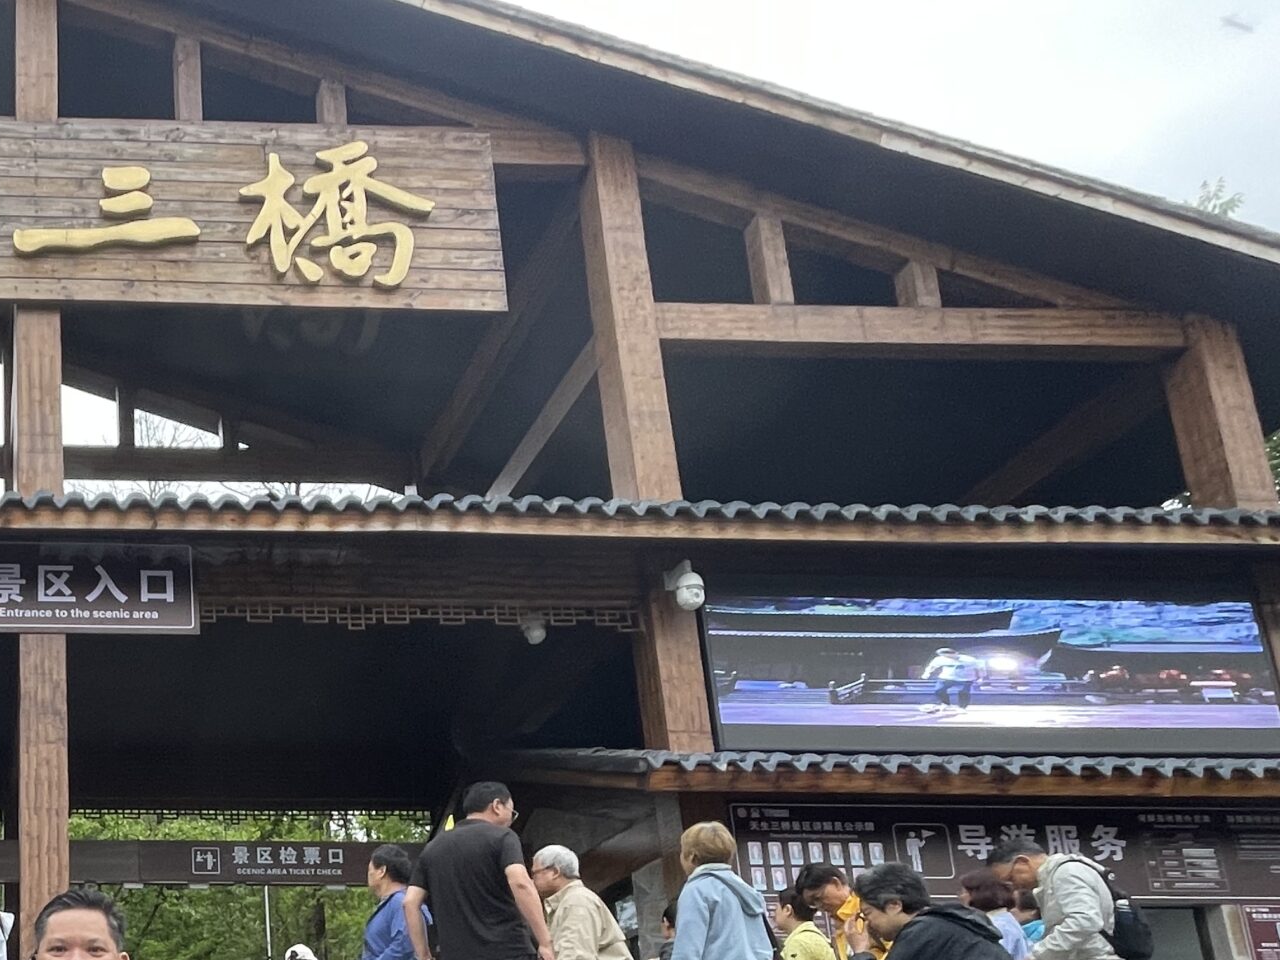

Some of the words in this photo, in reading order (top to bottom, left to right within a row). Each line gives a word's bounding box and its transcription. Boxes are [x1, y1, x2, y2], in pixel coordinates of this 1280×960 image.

[55, 608, 68, 618] to
[70, 607, 90, 619] the
[92, 607, 131, 620] scenic
[132, 609, 159, 620] area
[232, 846, 344, 865] 景区检票口
[236, 867, 265, 876] SCENIC
[266, 867, 288, 876] AREA
[289, 868, 316, 876] TICKET
[316, 868, 343, 876] CHECK
